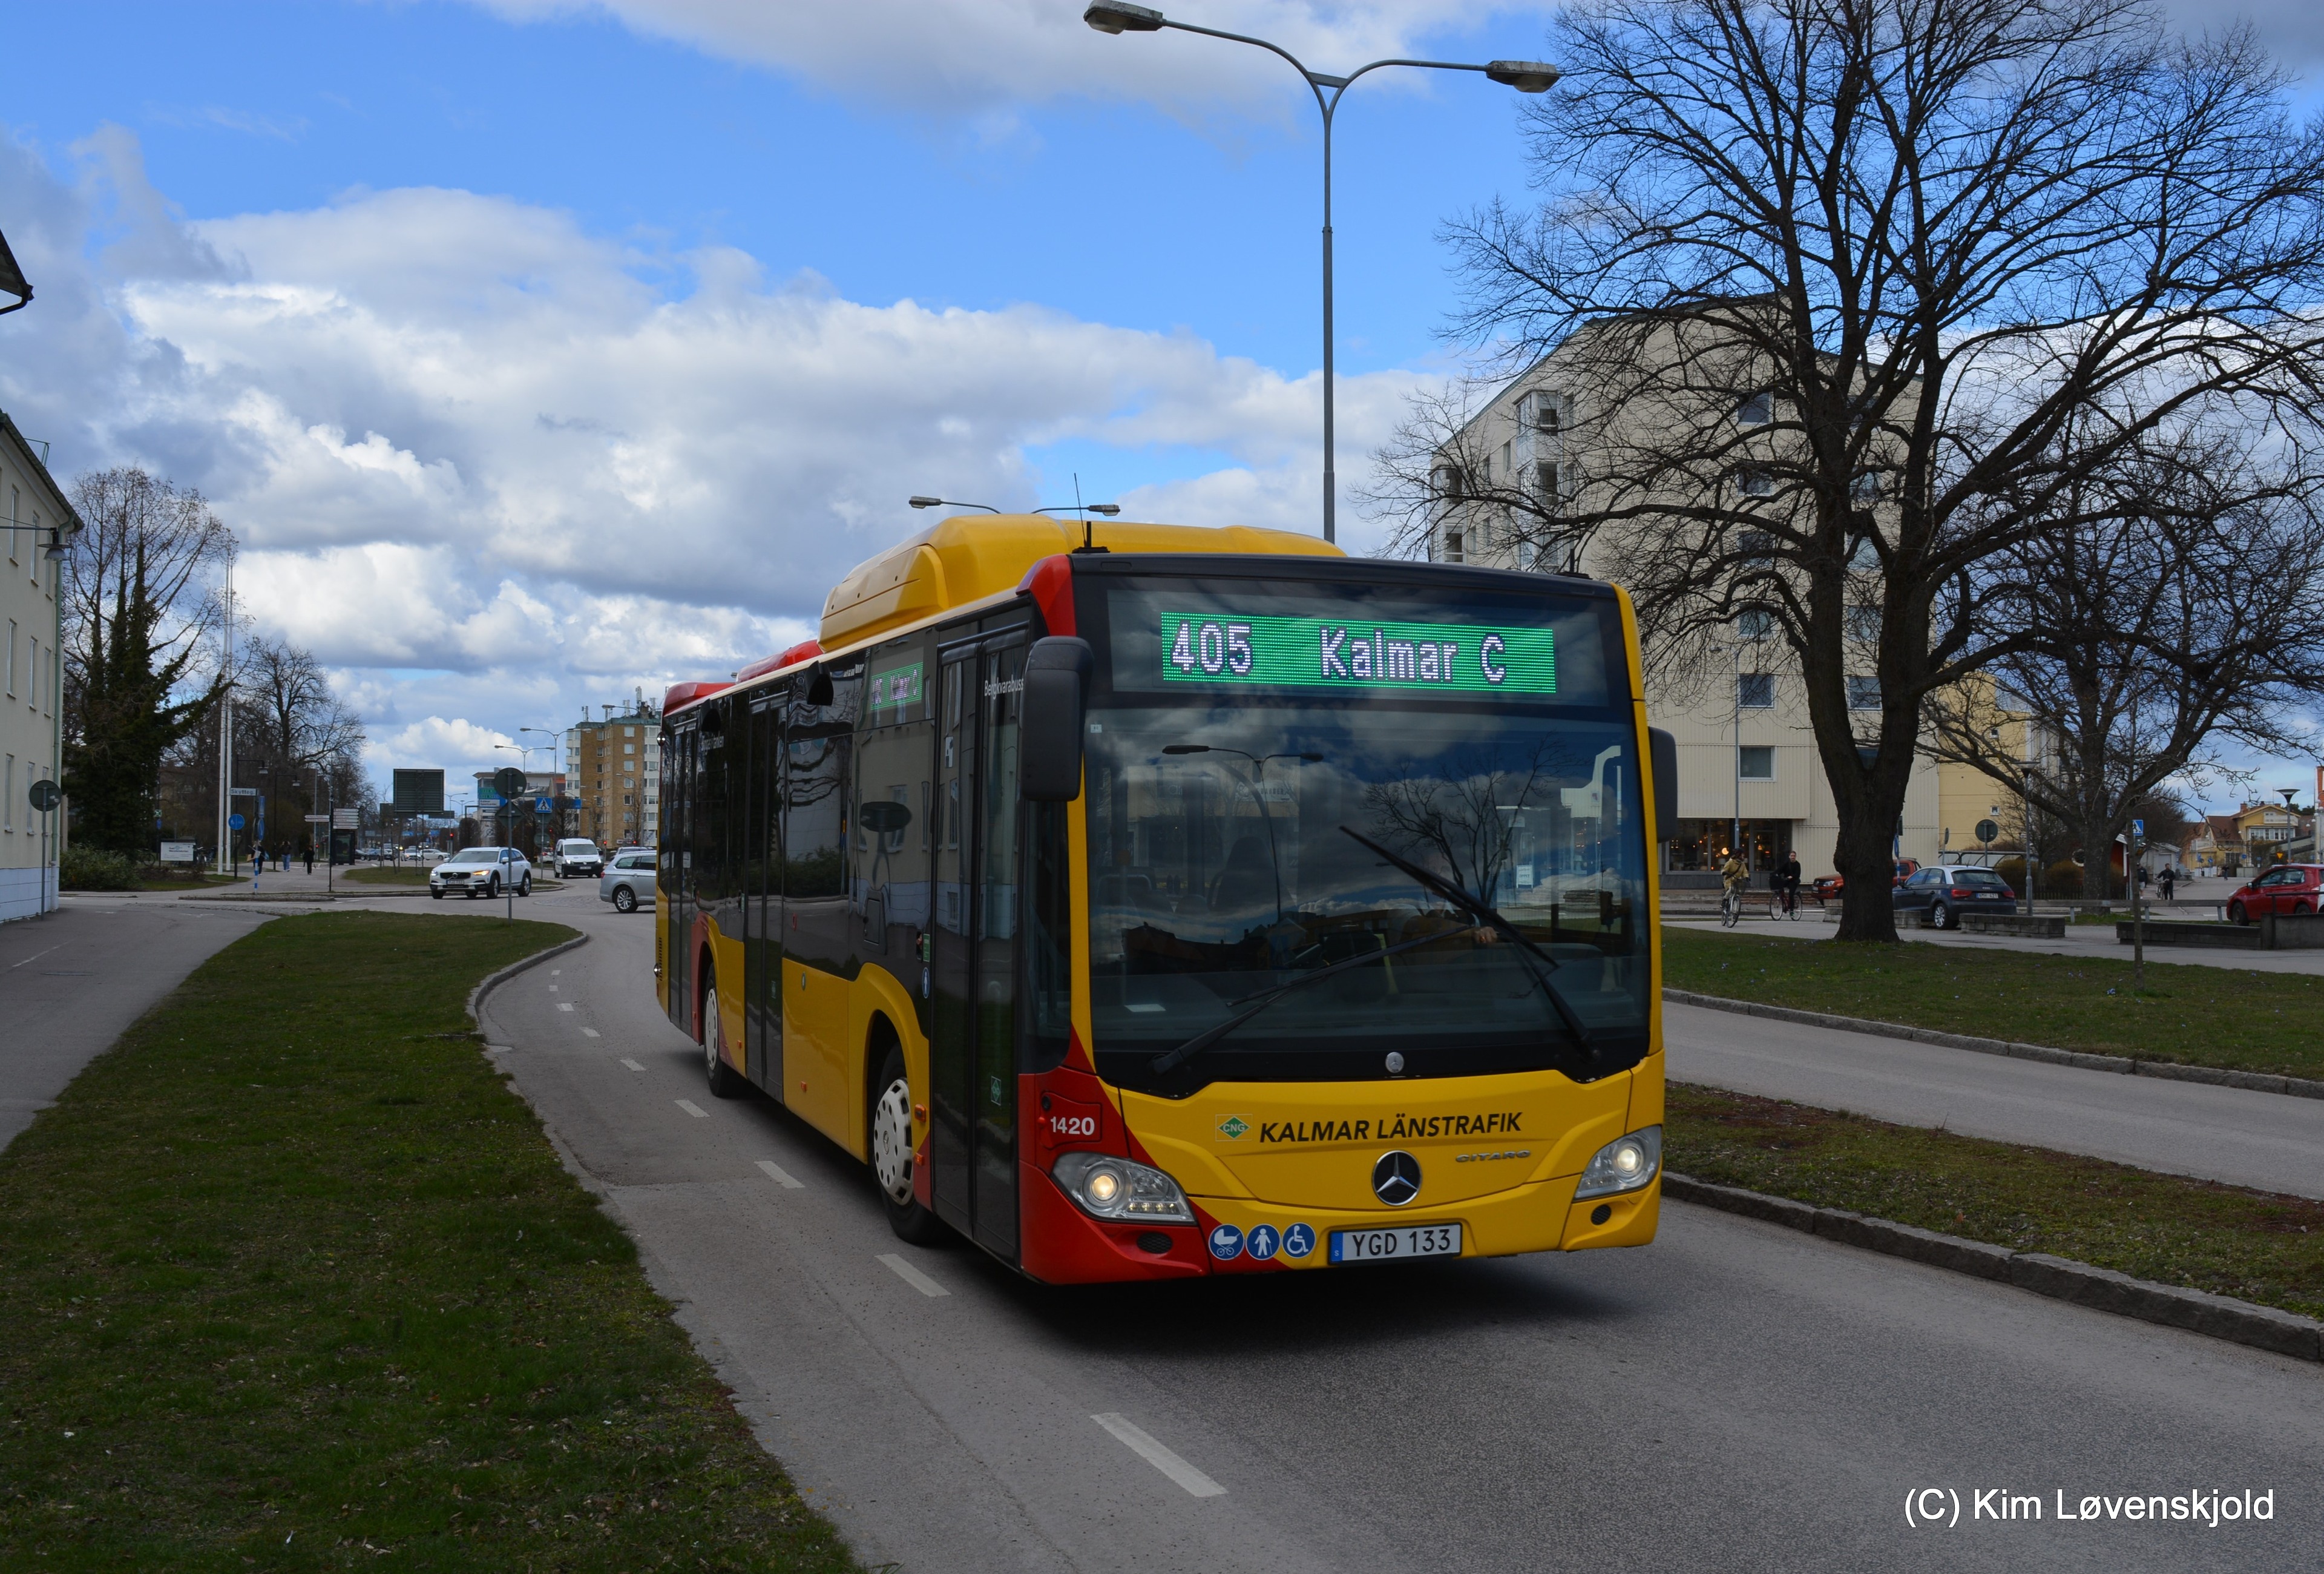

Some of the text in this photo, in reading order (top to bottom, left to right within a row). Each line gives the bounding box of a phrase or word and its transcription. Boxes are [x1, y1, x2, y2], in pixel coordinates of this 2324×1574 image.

[1172, 623, 1505, 681] 405 Kalmar C
[984, 674, 1024, 700] Bergkvarabuss
[1050, 1116, 1095, 1136] 1420
[1223, 1124, 1246, 1132] CNG
[1259, 1112, 1523, 1143] KALMAR LÄNSTRAFIK
[1456, 1150, 1531, 1162] CITARO
[1352, 1228, 1450, 1257] YGD 133
